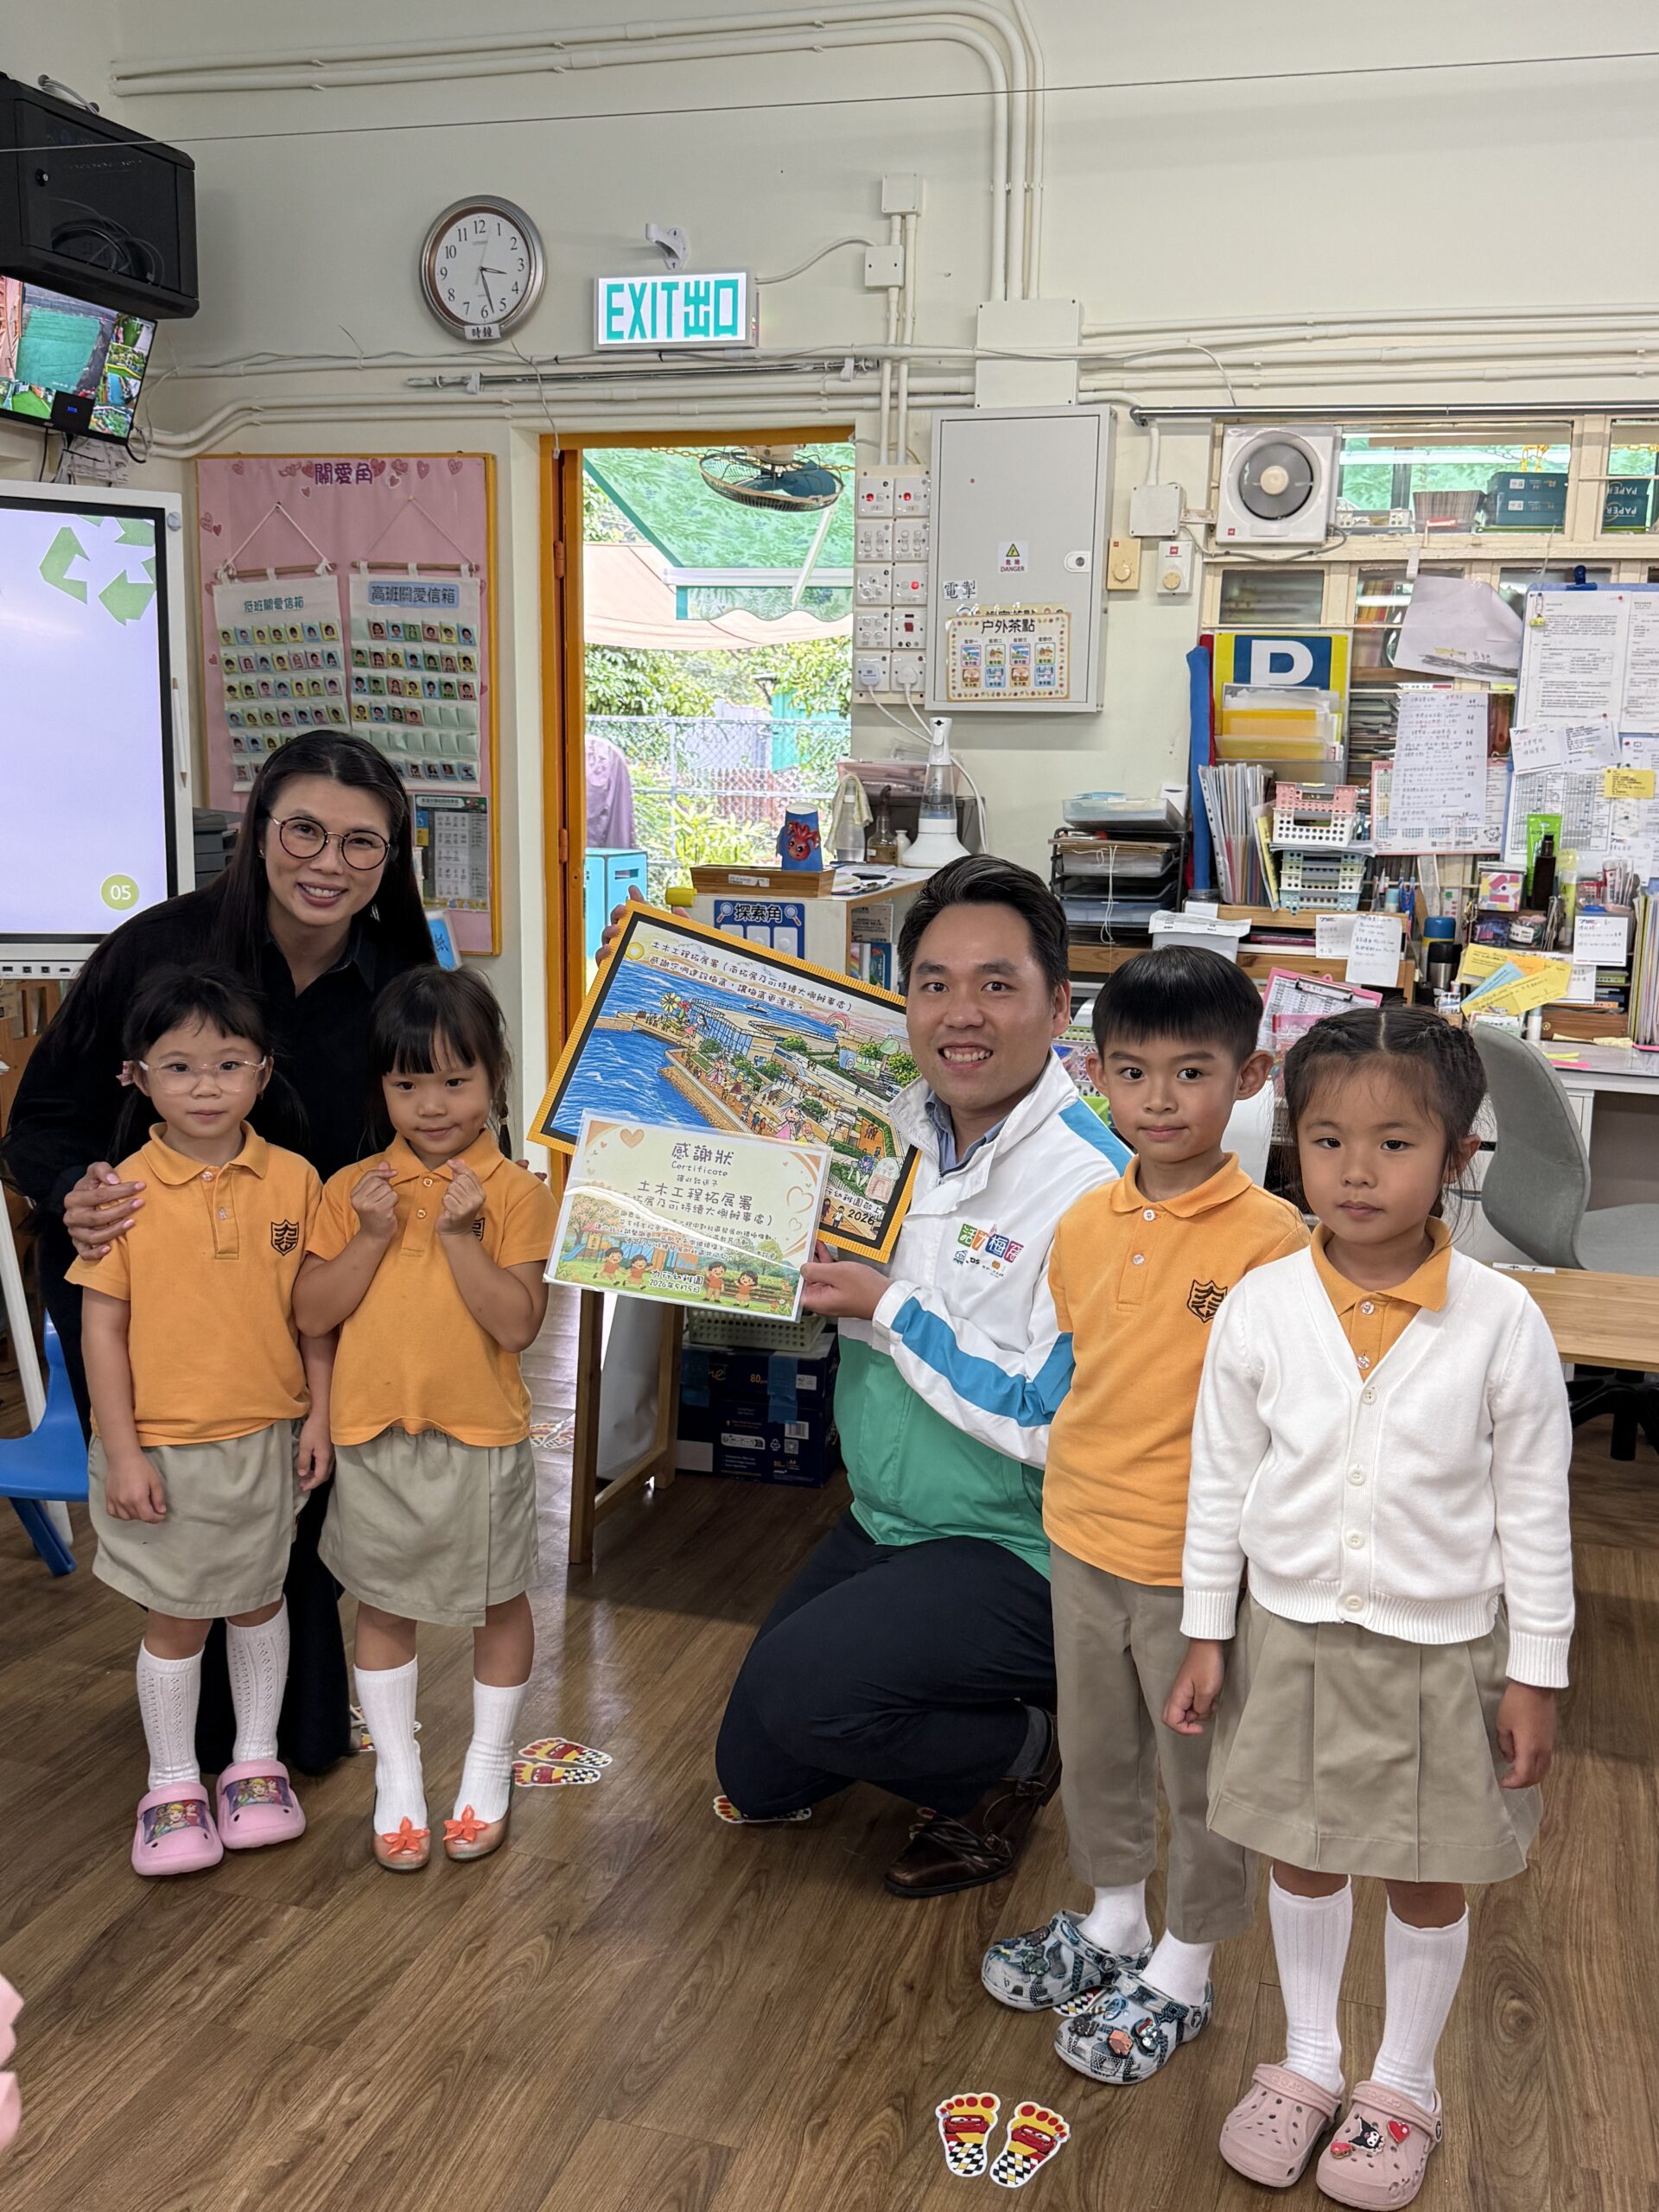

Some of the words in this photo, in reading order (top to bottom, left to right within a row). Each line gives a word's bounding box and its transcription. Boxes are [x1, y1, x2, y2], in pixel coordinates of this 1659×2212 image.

[474, 219, 486, 234] 12
[497, 222, 501, 236] 1
[458, 228, 467, 242] 11
[510, 237, 518, 251] 2
[445, 245, 457, 259] 10
[518, 257, 525, 272] 3
[440, 266, 448, 281] 9
[448, 288, 455, 302] 8
[512, 281, 519, 295] 4
[463, 302, 470, 315] 7
[480, 305, 489, 319] 6
[499, 298, 506, 312] 5
[607, 281, 679, 340] EXIT
[683, 279, 739, 338] 出口
[315, 462, 373, 485] 關愛角
[372, 585, 456, 604] 高班關愛信箱
[1250, 639, 1313, 685] P
[111, 885, 131, 900] 05
[734, 904, 782, 922] 探索角
[671, 1142, 734, 1166] 感謝狀
[671, 1160, 728, 1177] Certificate
[638, 1180, 753, 1211] 土木工程拓展署
[825, 1187, 882, 1213] 行幼稚園敬上
[848, 1210, 875, 1225] 2026
[652, 1270, 703, 1286] 力行幼稚園
[650, 1279, 700, 1293] 2026年5月5日
[750, 1373, 760, 1383] 80
